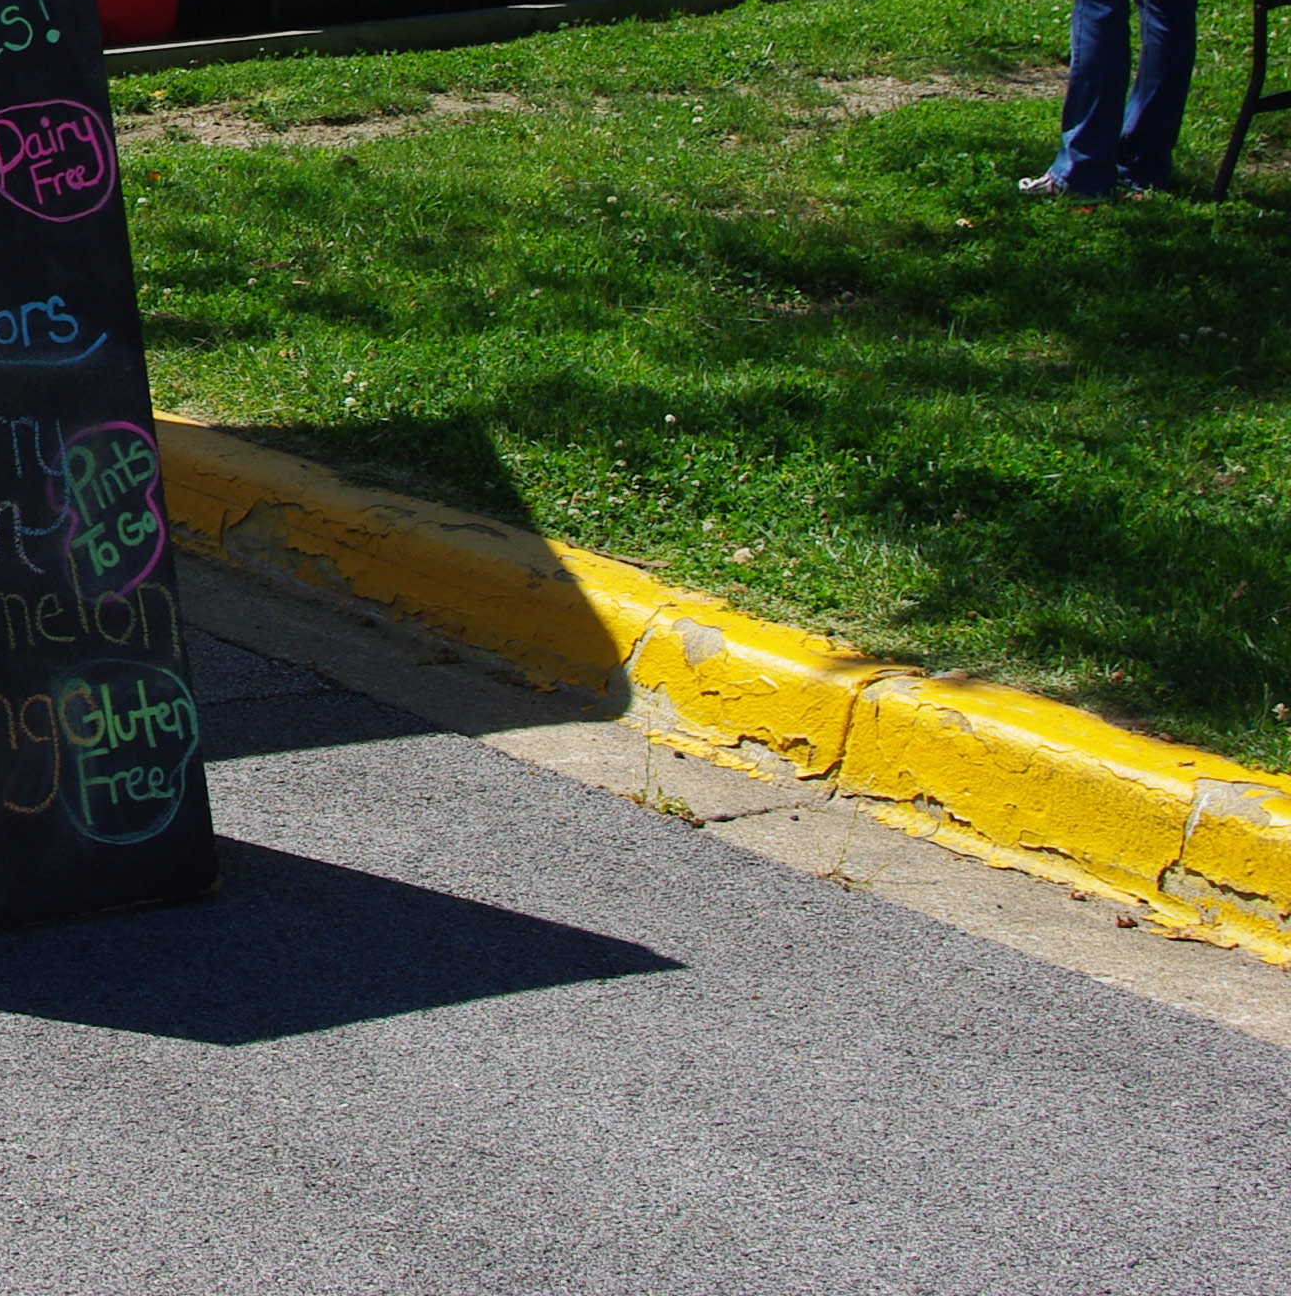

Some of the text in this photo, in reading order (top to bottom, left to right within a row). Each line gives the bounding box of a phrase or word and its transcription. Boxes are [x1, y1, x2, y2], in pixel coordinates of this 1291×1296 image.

[29, 159, 87, 204] Free
[66, 438, 157, 530] Pints
[71, 510, 157, 578] To Go
[61, 677, 198, 751] Gluten
[77, 749, 176, 826] Free
